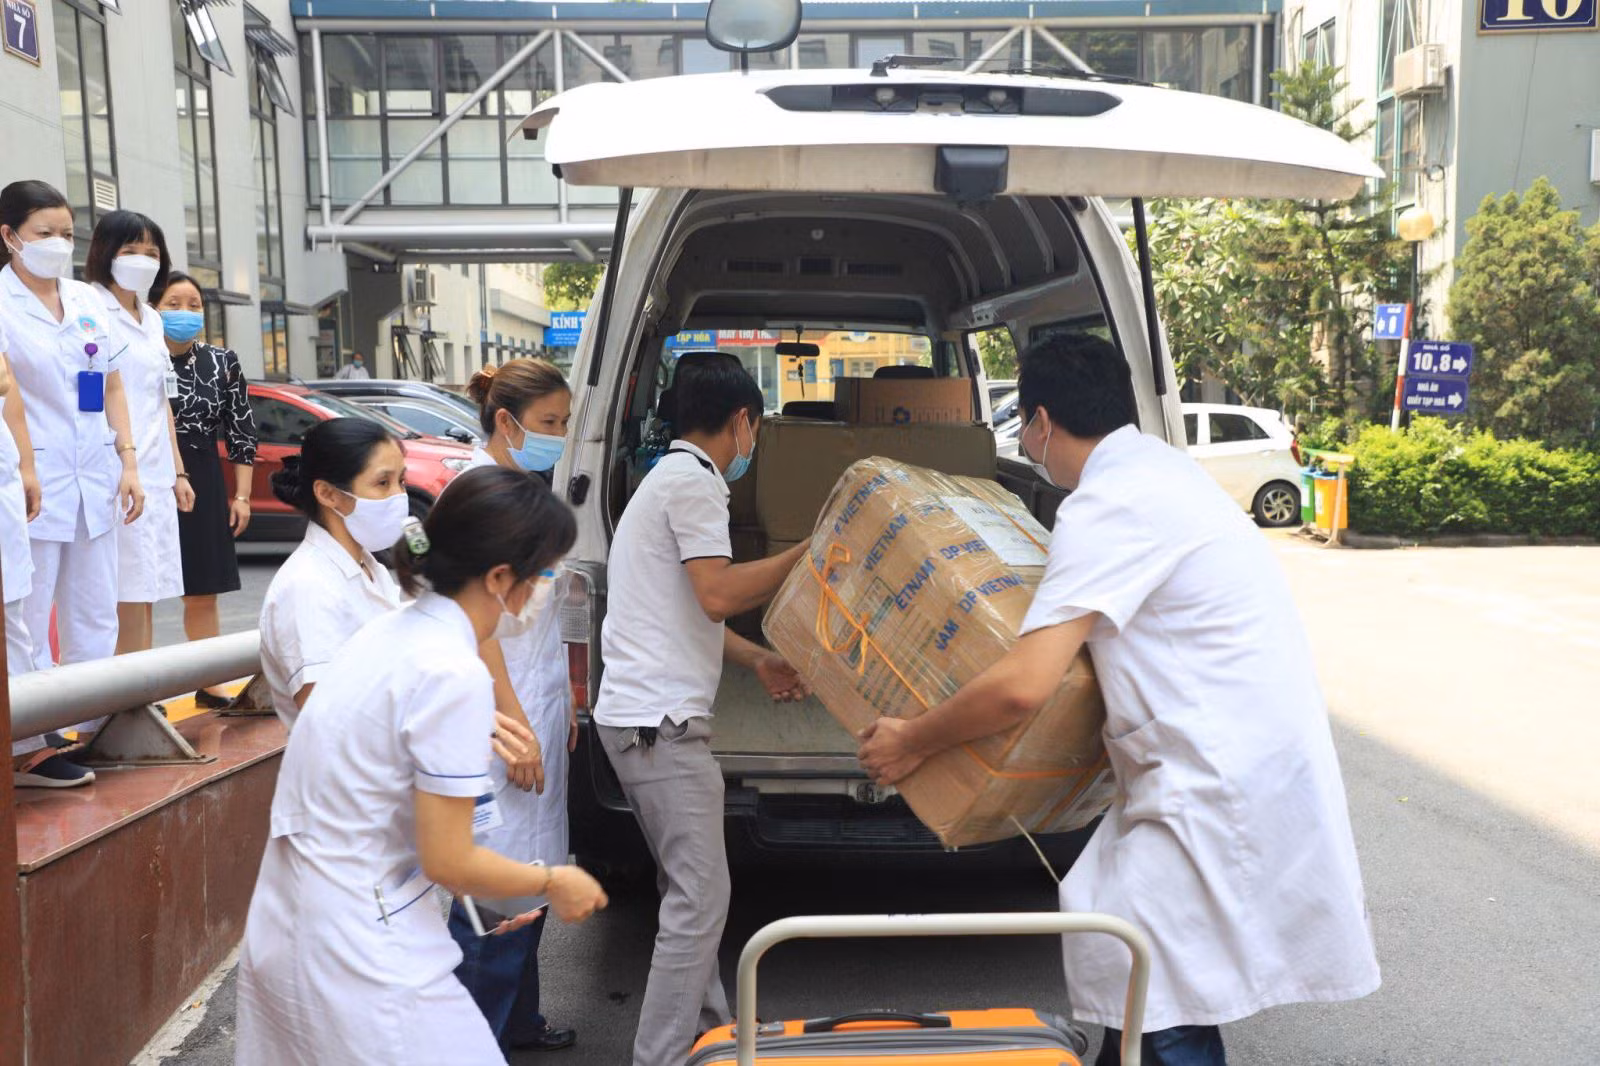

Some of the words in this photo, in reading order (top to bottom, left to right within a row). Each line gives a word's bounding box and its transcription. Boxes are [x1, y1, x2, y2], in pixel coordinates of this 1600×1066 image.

[13, 12, 26, 49] 7
[552, 313, 578, 329] KÍNH
[1413, 352, 1452, 373] 10,8
[863, 513, 909, 572] VIETNAM
[958, 589, 979, 615] DP
